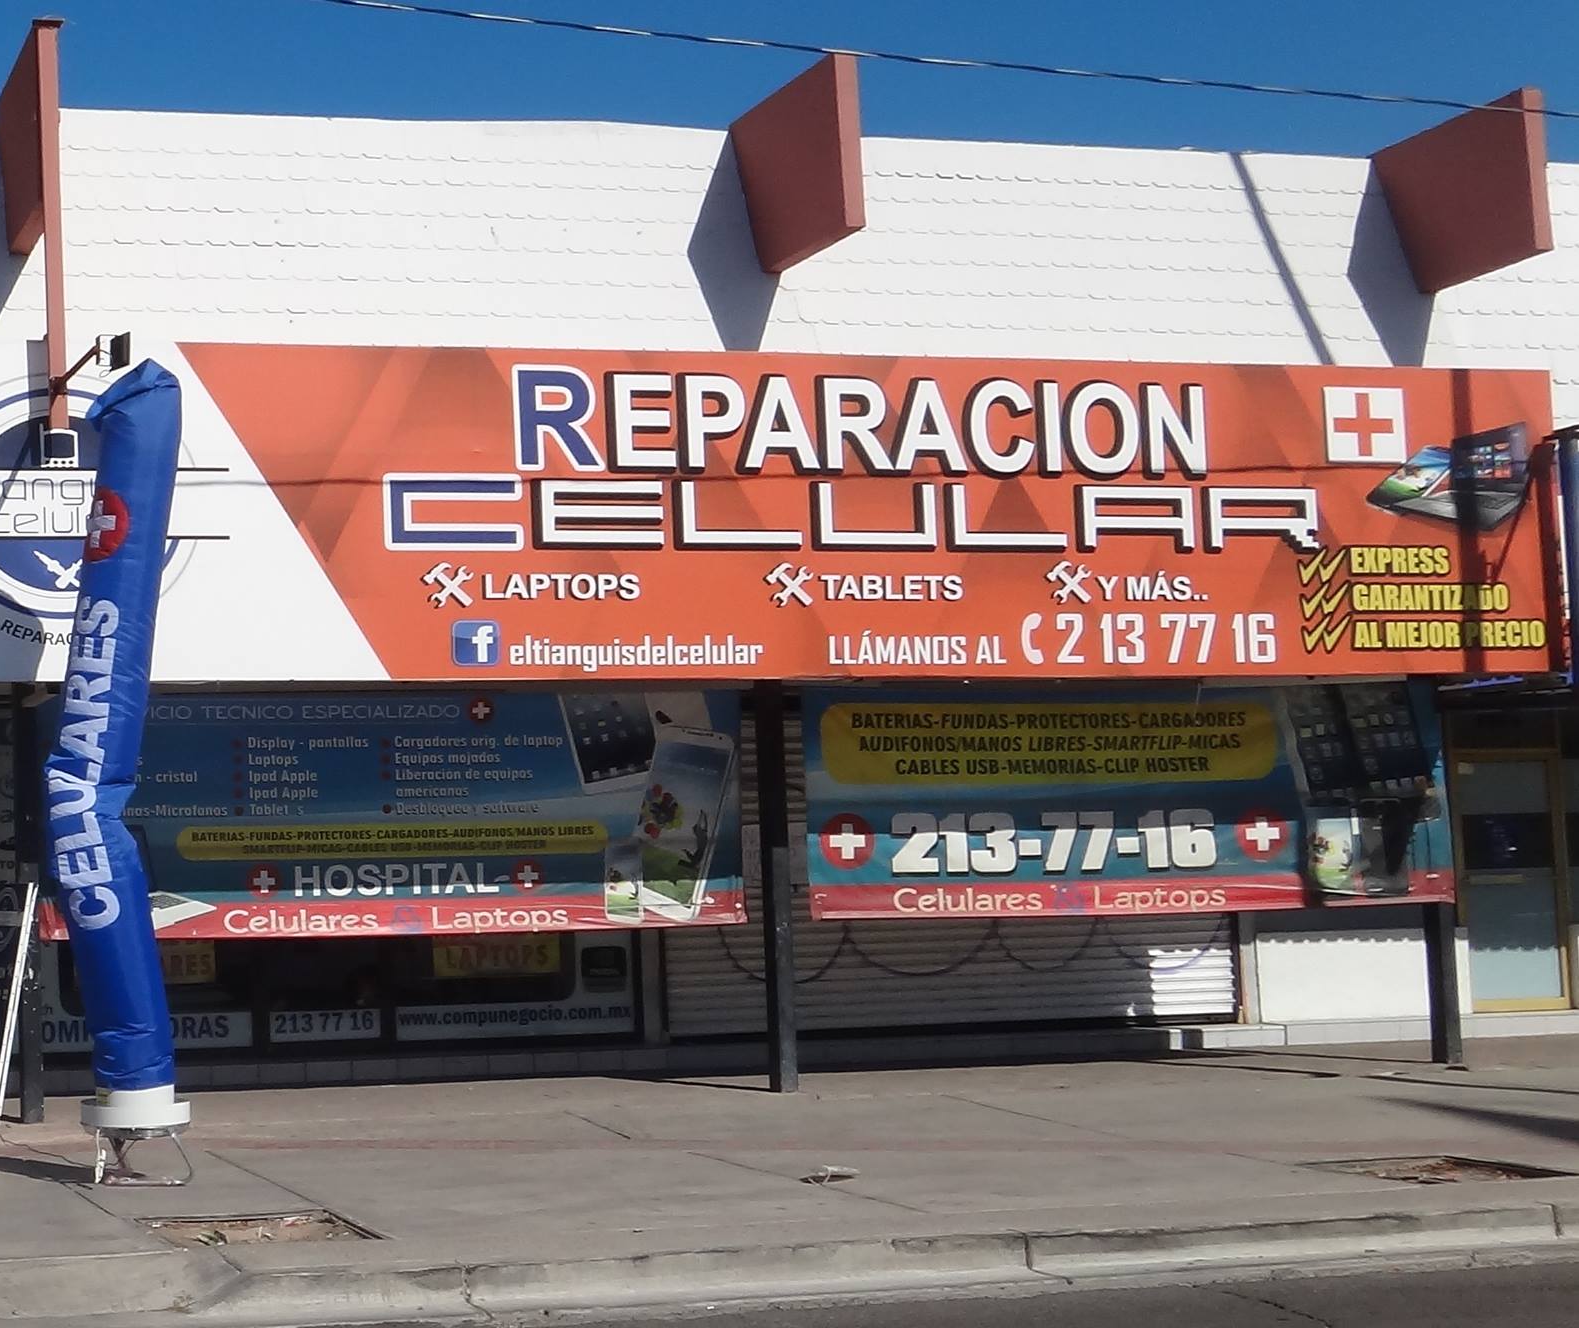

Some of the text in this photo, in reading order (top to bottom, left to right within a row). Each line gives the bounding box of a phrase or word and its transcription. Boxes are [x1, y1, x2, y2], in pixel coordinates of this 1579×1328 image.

[512, 364, 1207, 478] REPARACION
[383, 473, 1321, 552] CELULAR
[1350, 546, 1451, 575] EXPRESS
[482, 573, 641, 601] LAPTOPS
[820, 574, 964, 601] TABLETS
[1095, 575, 1118, 601] Y
[1352, 583, 1510, 612] GARANTIZADO
[828, 611, 1277, 666] LLÁMANOS AL 2 13 77 16
[1353, 619, 1547, 650] AL MEJOR PRECIO
[509, 634, 764, 673] eltianguisdelcelular
[201, 704, 294, 720] TECNICO
[302, 703, 461, 720] ESPECIALIZADO
[247, 736, 295, 751] Display
[308, 735, 369, 750] pantallas
[394, 734, 563, 750] Cargadores orig. de laptop
[247, 753, 299, 768] Laptops
[395, 751, 501, 766] Equipos mojados
[895, 758, 960, 776] CABLES
[1146, 756, 1211, 774] HOSTER
[155, 770, 198, 784] cristal
[248, 769, 318, 784] Ipod Apple
[465, 767, 480, 780] de
[484, 767, 534, 782] equipos
[281, 786, 319, 800] Apple
[395, 784, 470, 798] americanos
[557, 825, 595, 836] LIBRES
[889, 808, 1218, 877] 213-77-16
[294, 862, 501, 898] HOSPITAL
[893, 886, 1044, 913] Celulares
[1093, 885, 1228, 912] Laptops
[223, 908, 379, 934] Celulares
[430, 905, 570, 935] Laptops
[445, 944, 550, 970] LAPTOPS
[274, 1010, 375, 1034] 213 77 16
[397, 1004, 632, 1027] www.compunegocio.com.mx
